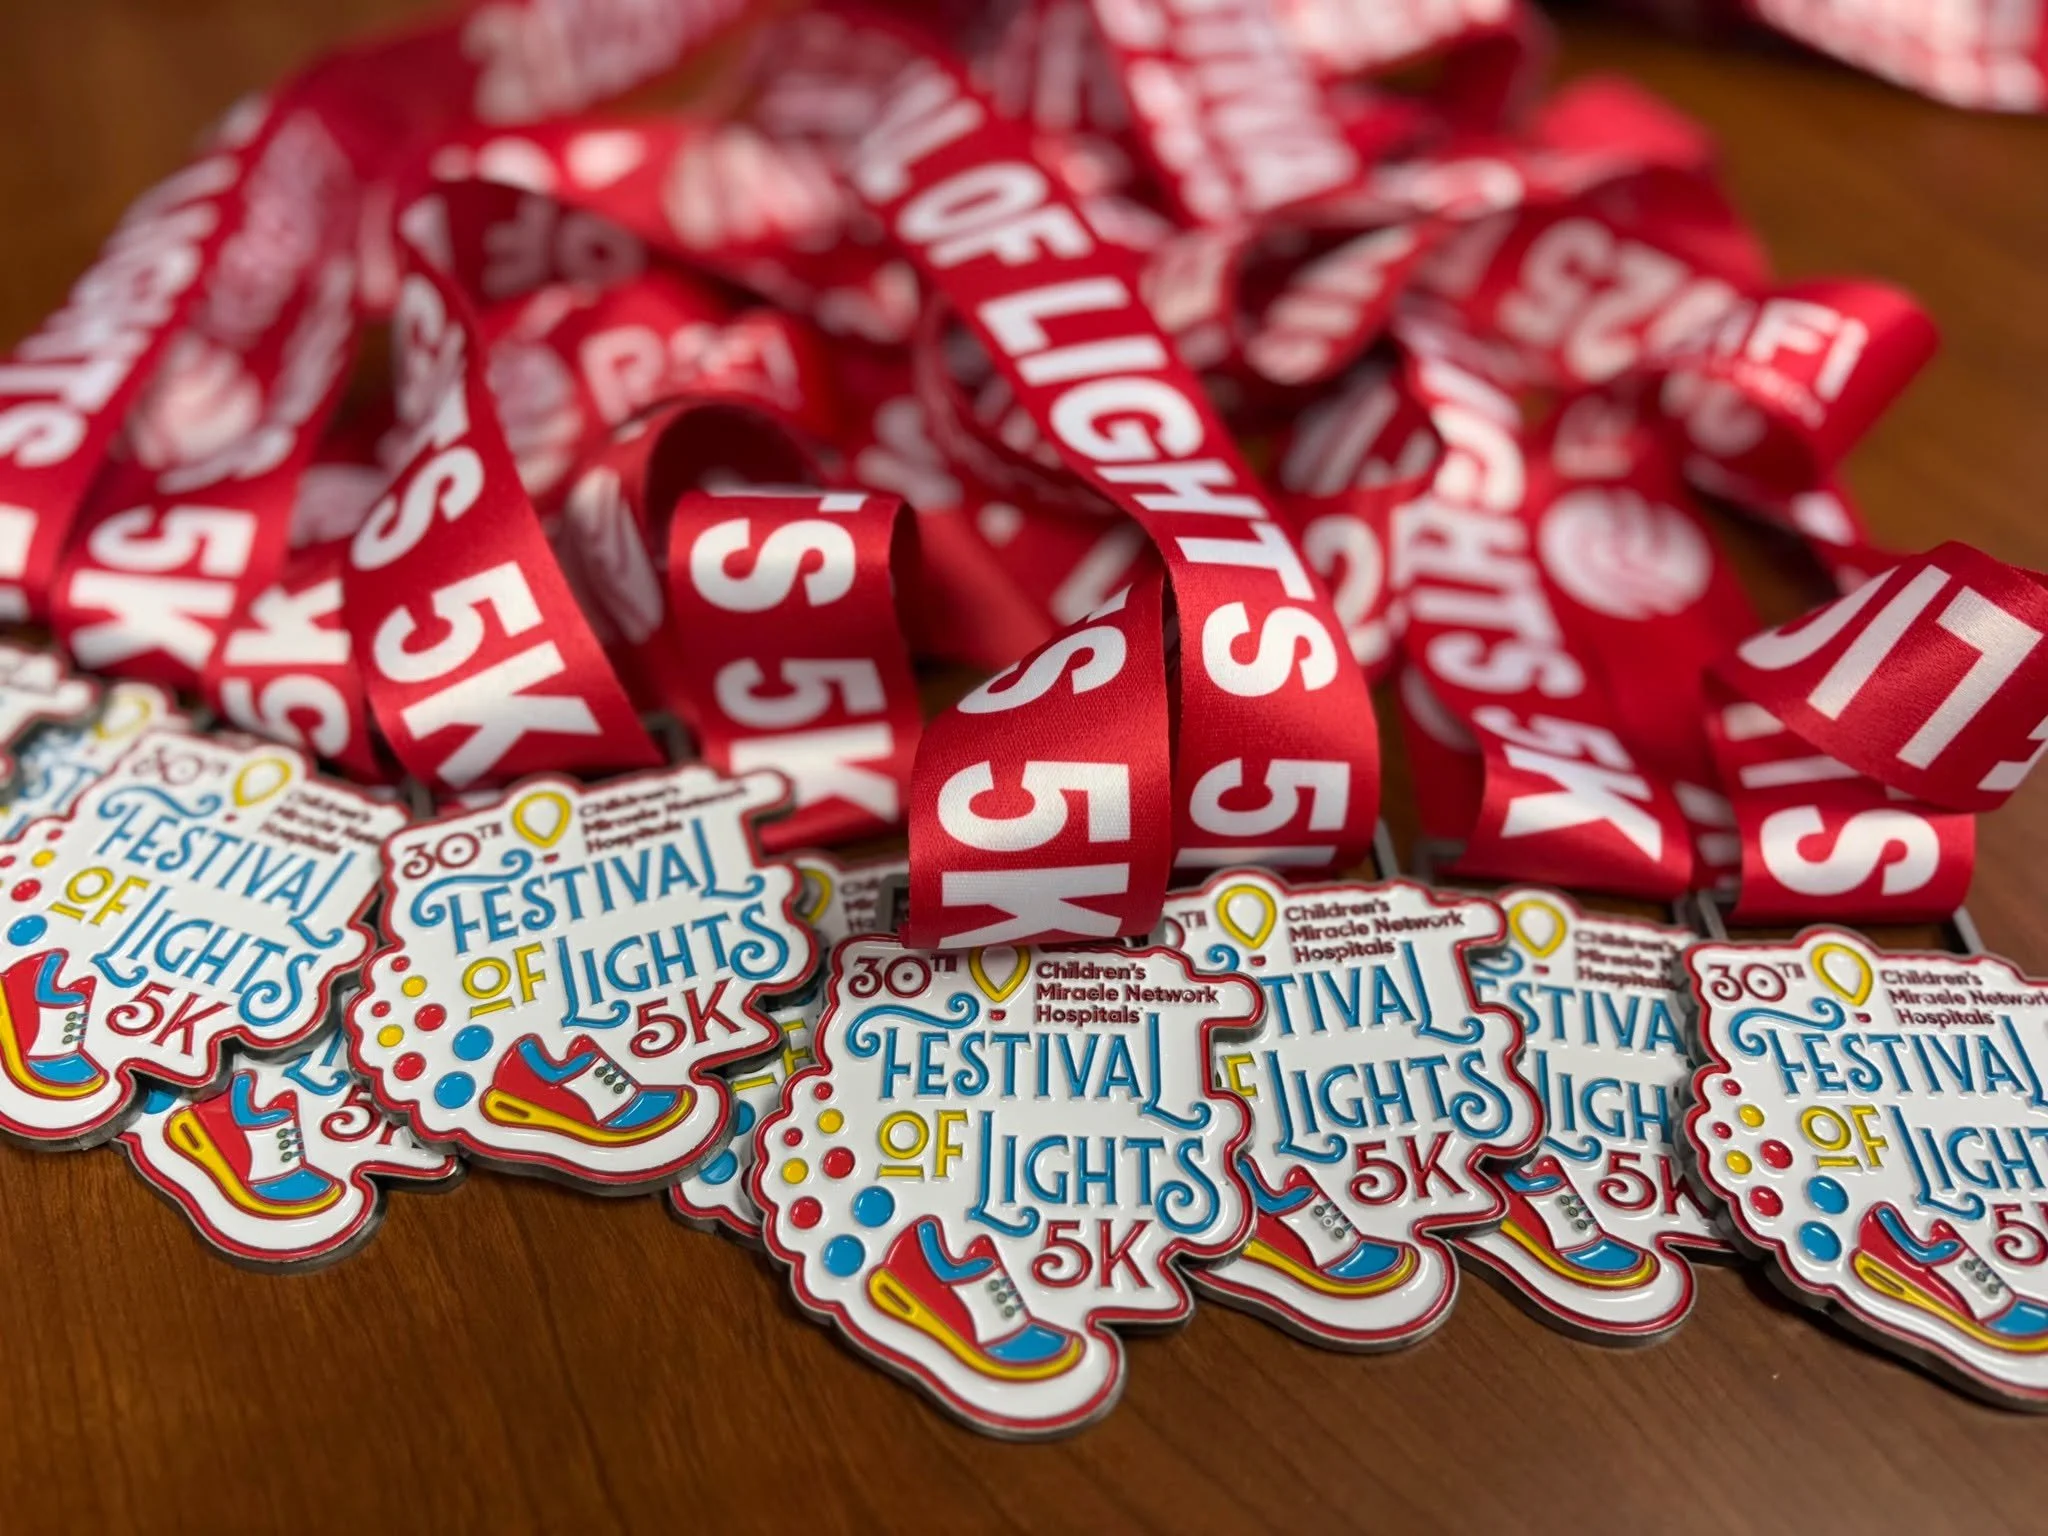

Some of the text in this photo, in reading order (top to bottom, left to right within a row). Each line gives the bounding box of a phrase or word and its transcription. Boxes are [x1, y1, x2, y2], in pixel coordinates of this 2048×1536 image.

[899, 162, 1092, 267] OF
[979, 277, 1338, 697] LIGHTS
[69, 505, 257, 672] 5K
[219, 577, 352, 757] 5K
[373, 560, 602, 788] 5K
[714, 658, 899, 825] 5K
[579, 786, 682, 819] Children's
[582, 808, 660, 836] Miracle
[587, 819, 684, 855] Hospitals
[1174, 757, 1350, 868] 5
[98, 785, 358, 949] FESTIVAL
[410, 818, 766, 956] FESTIVAL
[938, 760, 1131, 949] 5K
[48, 867, 149, 926] OF
[1284, 899, 1391, 922] Children's
[1289, 910, 1465, 943] Miracle Network
[90, 887, 321, 1028] LIGHTS
[462, 942, 548, 1019] OF
[555, 901, 790, 1029] LIGHTS
[1035, 960, 1147, 981] Children's
[1293, 938, 1396, 965] Hospitals
[1880, 968, 1984, 989] Children's
[105, 981, 234, 1057] 5K
[630, 977, 743, 1058] 5K
[1035, 983, 1220, 1004] Miracle Network
[1035, 1004, 1142, 1028] Hospitals
[1256, 941, 1486, 1044] TIVAL
[1889, 989, 1968, 1008] Miracle
[1899, 1008, 1996, 1030] Hospitals
[845, 992, 1212, 1130] FESTIVAL
[1729, 997, 2048, 1112] FESTIVAL
[878, 1109, 969, 1180] OF
[1266, 1048, 1513, 1164] LIGHTS
[1536, 1049, 1676, 1162] LIGH
[1800, 1103, 1889, 1170] OF
[967, 1110, 1222, 1238] LIGHTS
[1349, 1131, 1470, 1204] 5K
[1885, 1104, 2048, 1221] LIGH
[1031, 1219, 1155, 1291] 5K
[1993, 1201, 2048, 1267] 5
